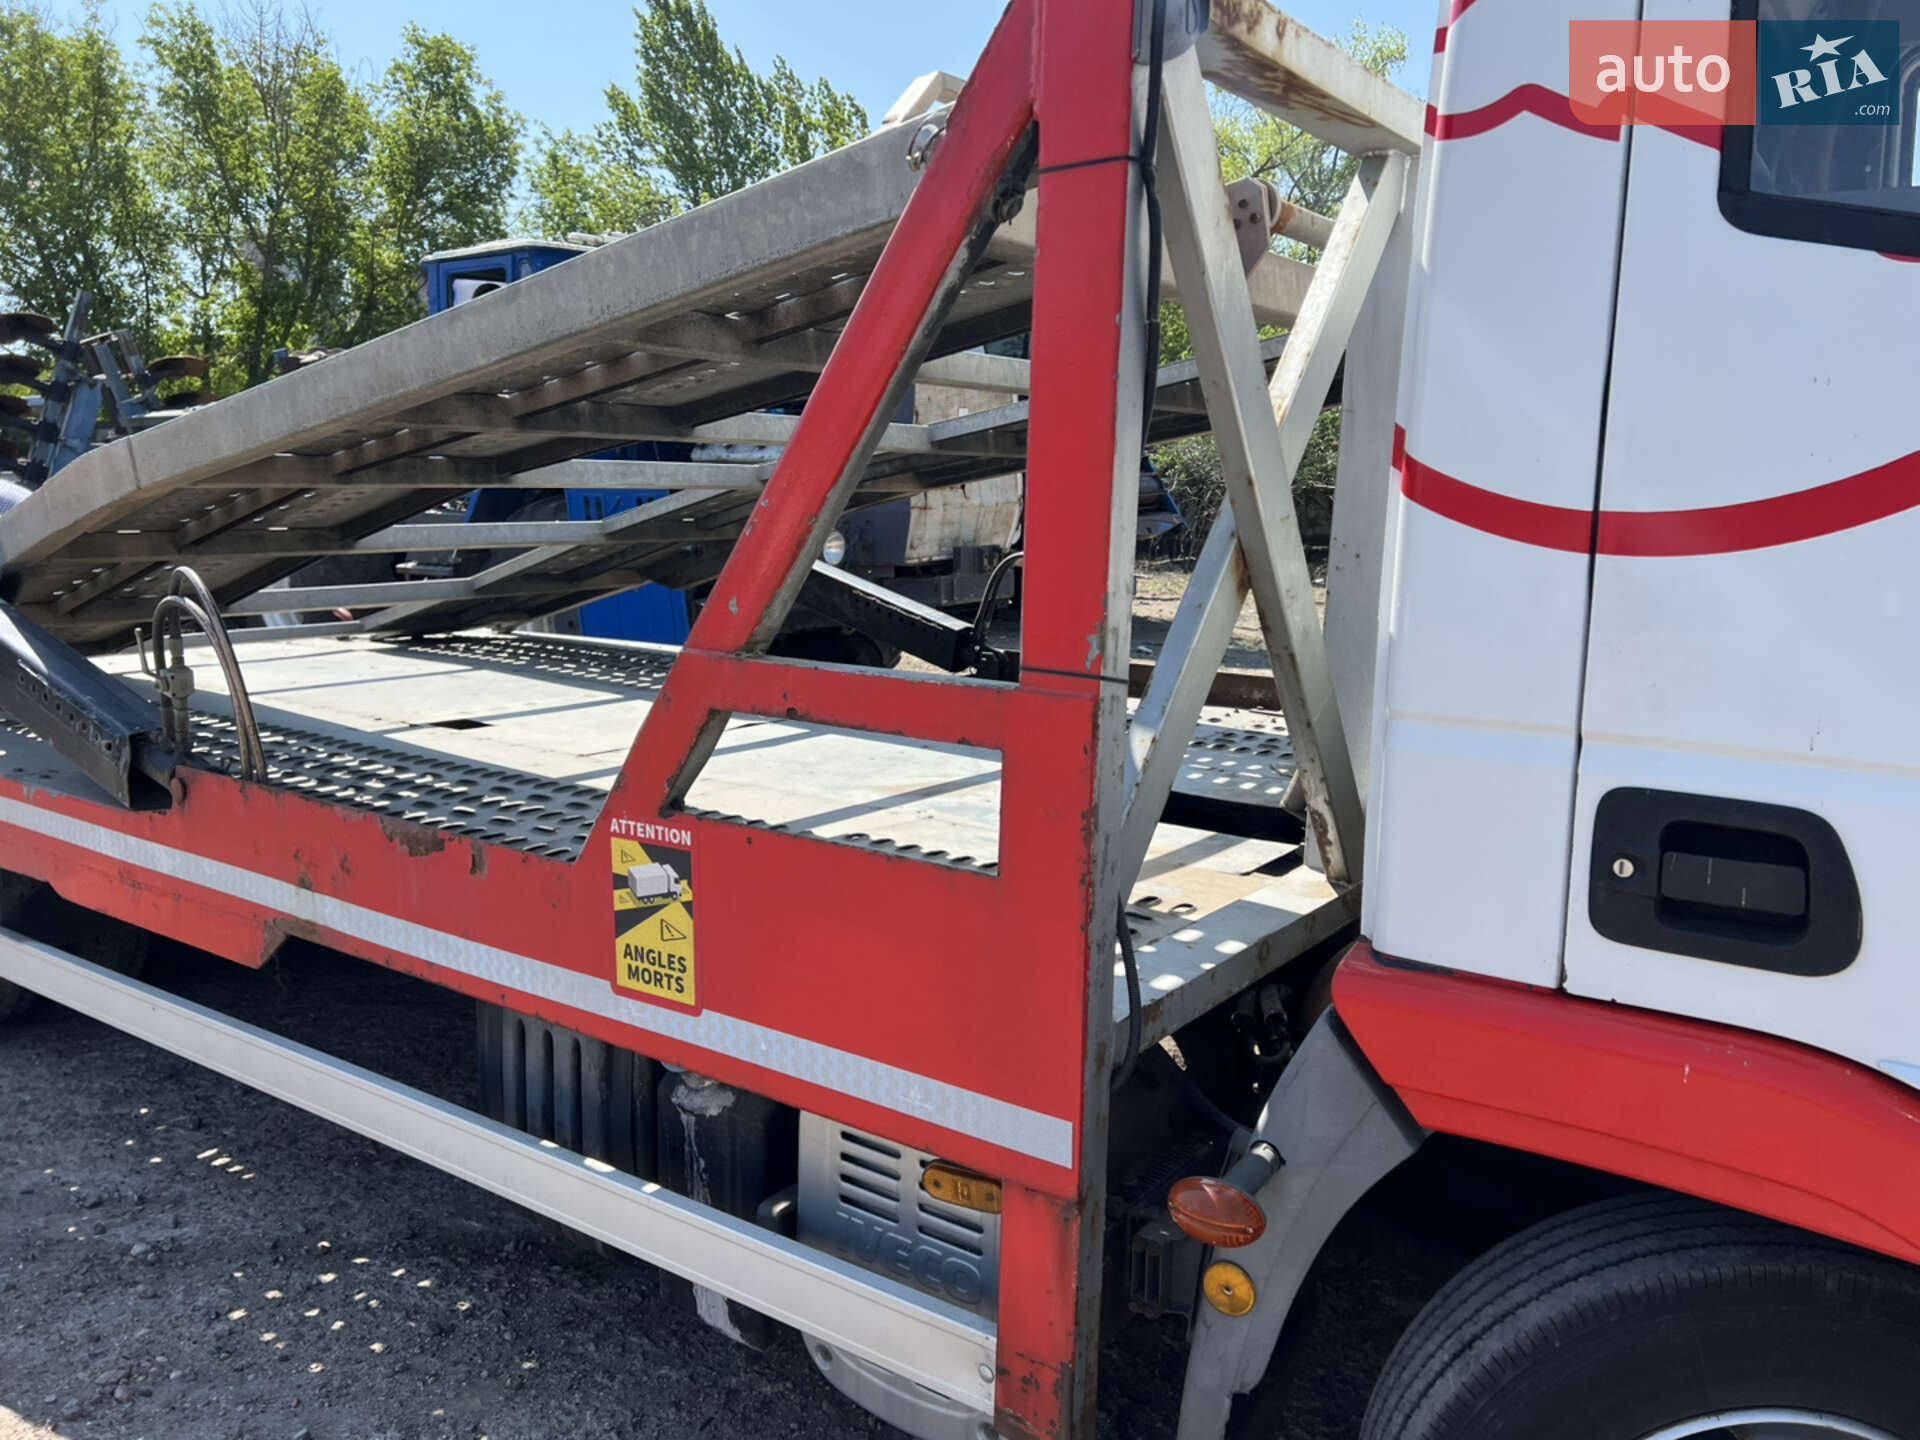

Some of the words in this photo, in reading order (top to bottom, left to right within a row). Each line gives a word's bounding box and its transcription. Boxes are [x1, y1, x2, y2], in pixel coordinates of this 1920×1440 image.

[610, 818, 692, 846] ATTENTION
[623, 943, 687, 974] ANGLES
[627, 963, 685, 994] MORTS
[835, 1210, 984, 1305] IVECO
